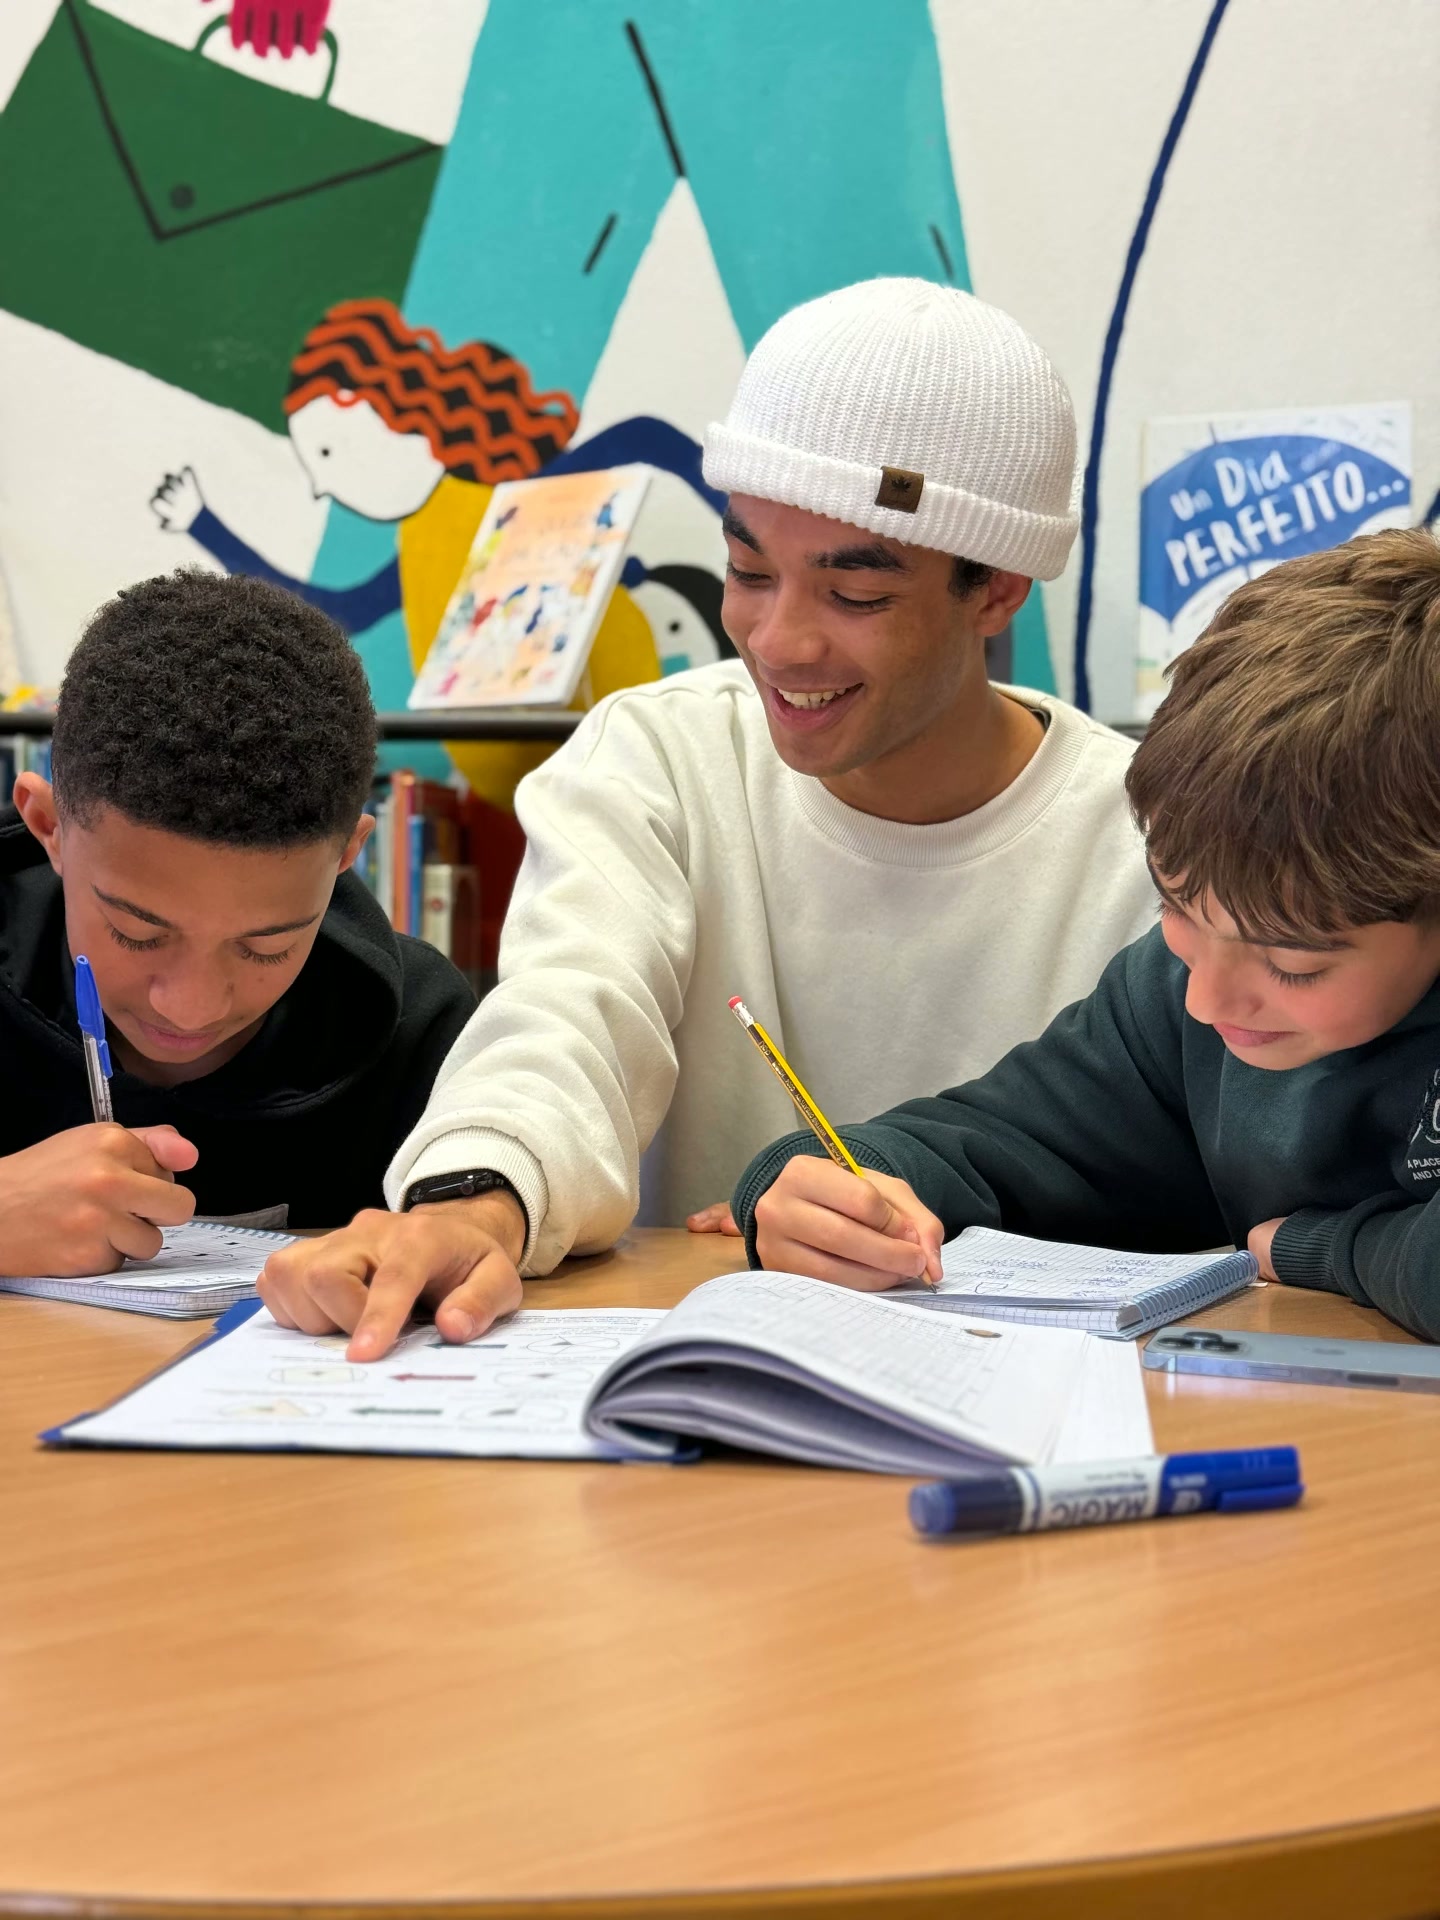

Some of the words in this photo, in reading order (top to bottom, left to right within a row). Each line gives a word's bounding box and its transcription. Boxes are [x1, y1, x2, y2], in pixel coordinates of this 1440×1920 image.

[1214, 450, 1292, 508] Dia
[1165, 461, 1405, 587] PERFEITO...
[1407, 1159, 1413, 1169] A
[1412, 1170, 1433, 1181] AND
[1052, 1496, 1148, 1525] MAGIC
